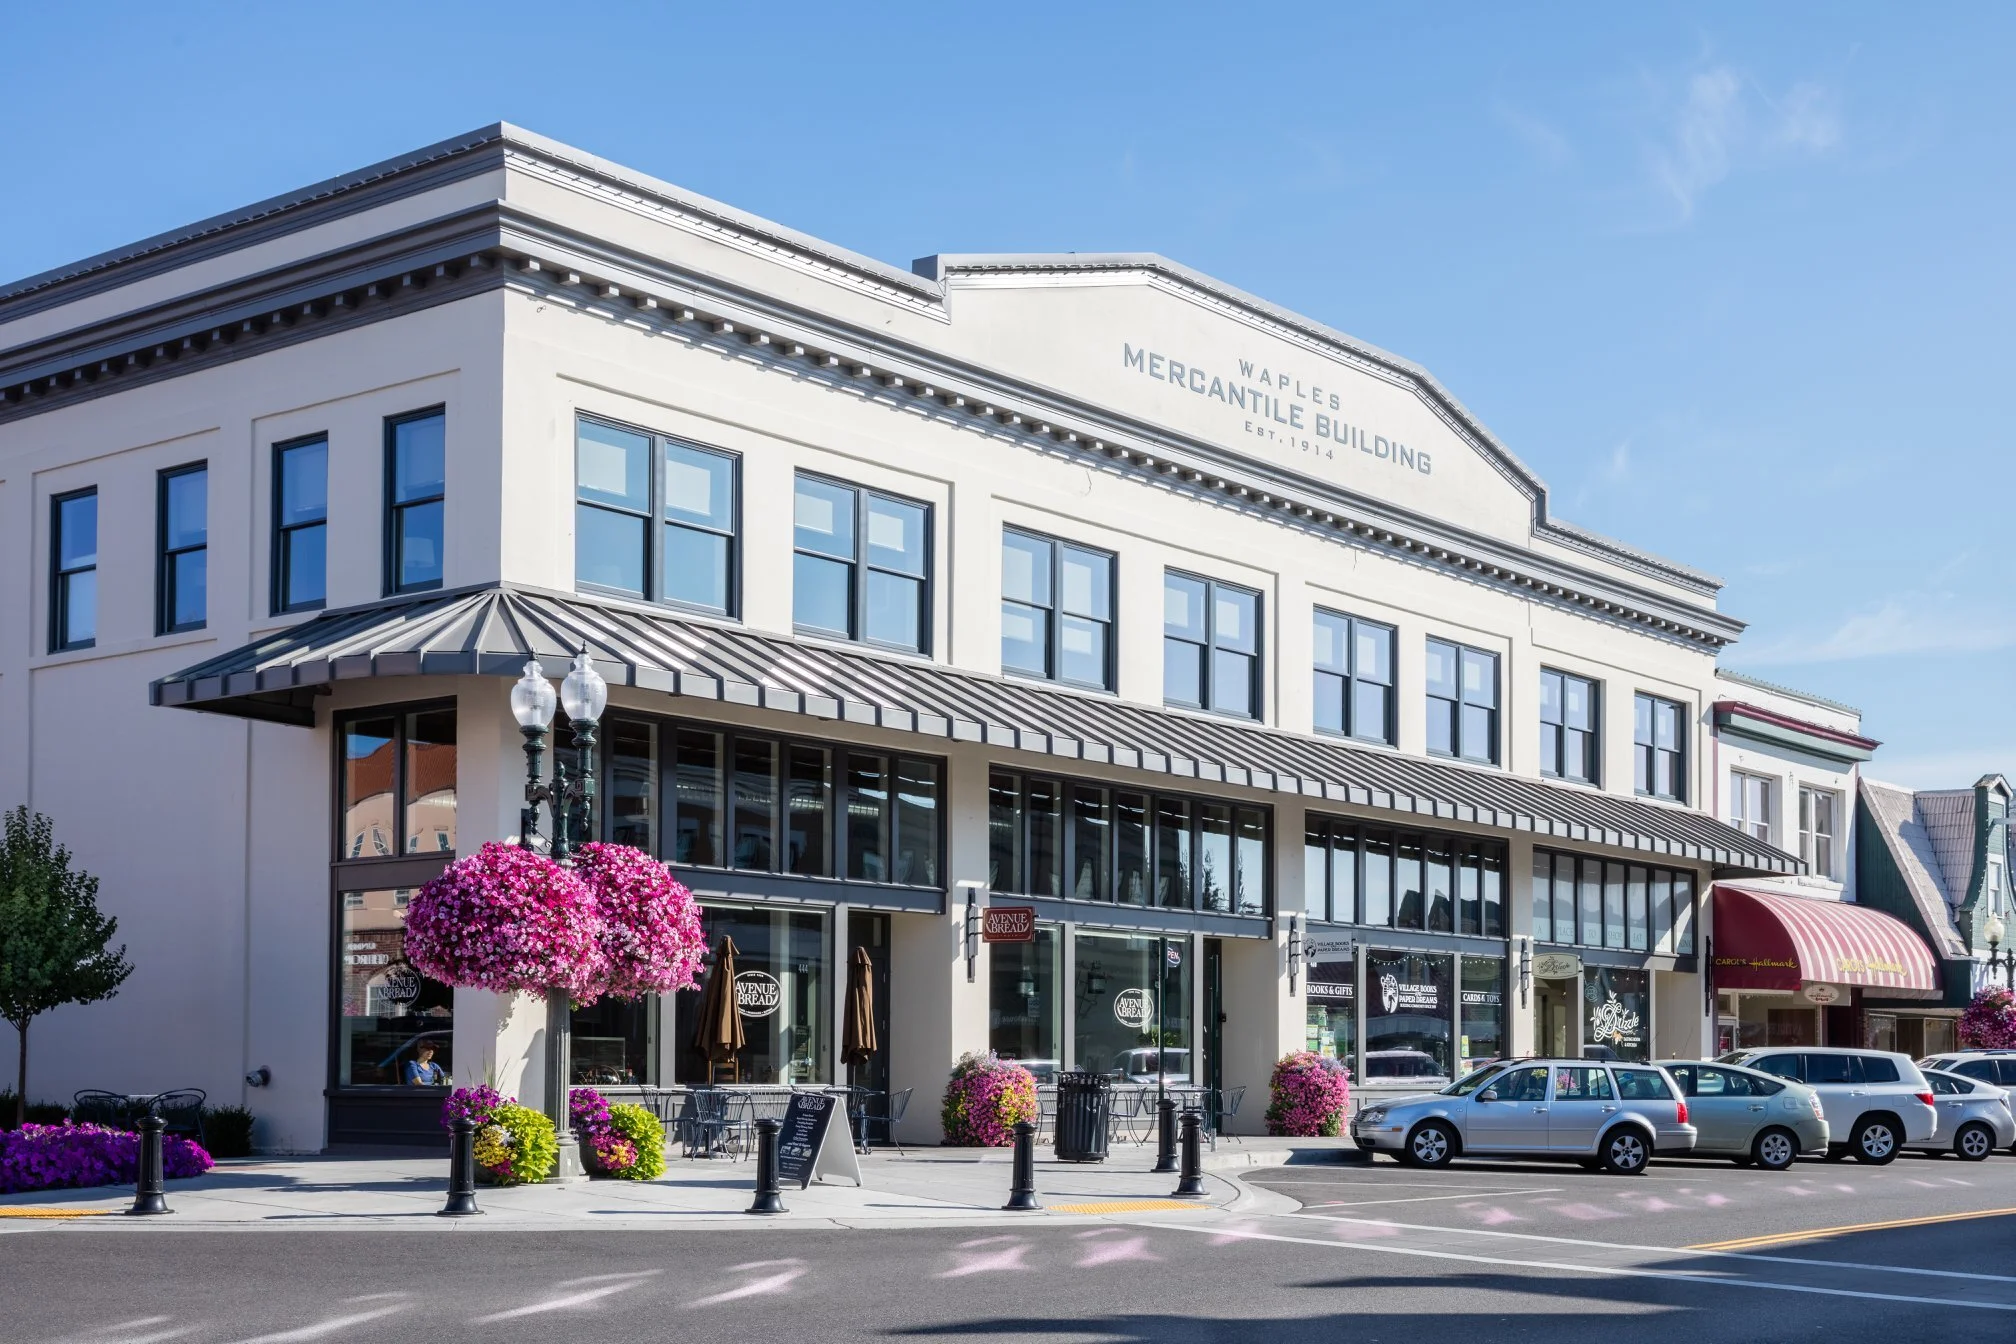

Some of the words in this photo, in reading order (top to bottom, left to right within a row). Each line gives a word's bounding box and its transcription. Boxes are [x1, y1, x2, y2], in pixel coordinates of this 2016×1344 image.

[1238, 358, 1340, 411] WAPLES
[1123, 342, 1304, 430] MERCANTILE
[1314, 412, 1432, 476] BUILDING
[988, 913, 1028, 923] AVENUE
[991, 923, 1025, 934] BREAD
[798, 963, 809, 973] 444
[1748, 956, 1798, 972] Hallmark
[383, 987, 413, 998] BREAD
[735, 981, 777, 995] AVENUE
[1306, 984, 1328, 995] BOOKS
[1329, 986, 1335, 995] &
[1335, 986, 1353, 996] GIFTS
[1398, 984, 1420, 992] VILLAGE
[1420, 985, 1437, 993] BOOKS
[737, 993, 774, 1006] BREAD
[1399, 995, 1416, 1003] PAPER
[1416, 996, 1438, 1004] DREAMS
[1462, 993, 1480, 1002] CARDS
[1486, 995, 1500, 1003] TOYS
[1120, 1006, 1148, 1017] BREAD
[800, 1096, 826, 1105] AVENUE
[800, 1101, 823, 1111] BREAD
